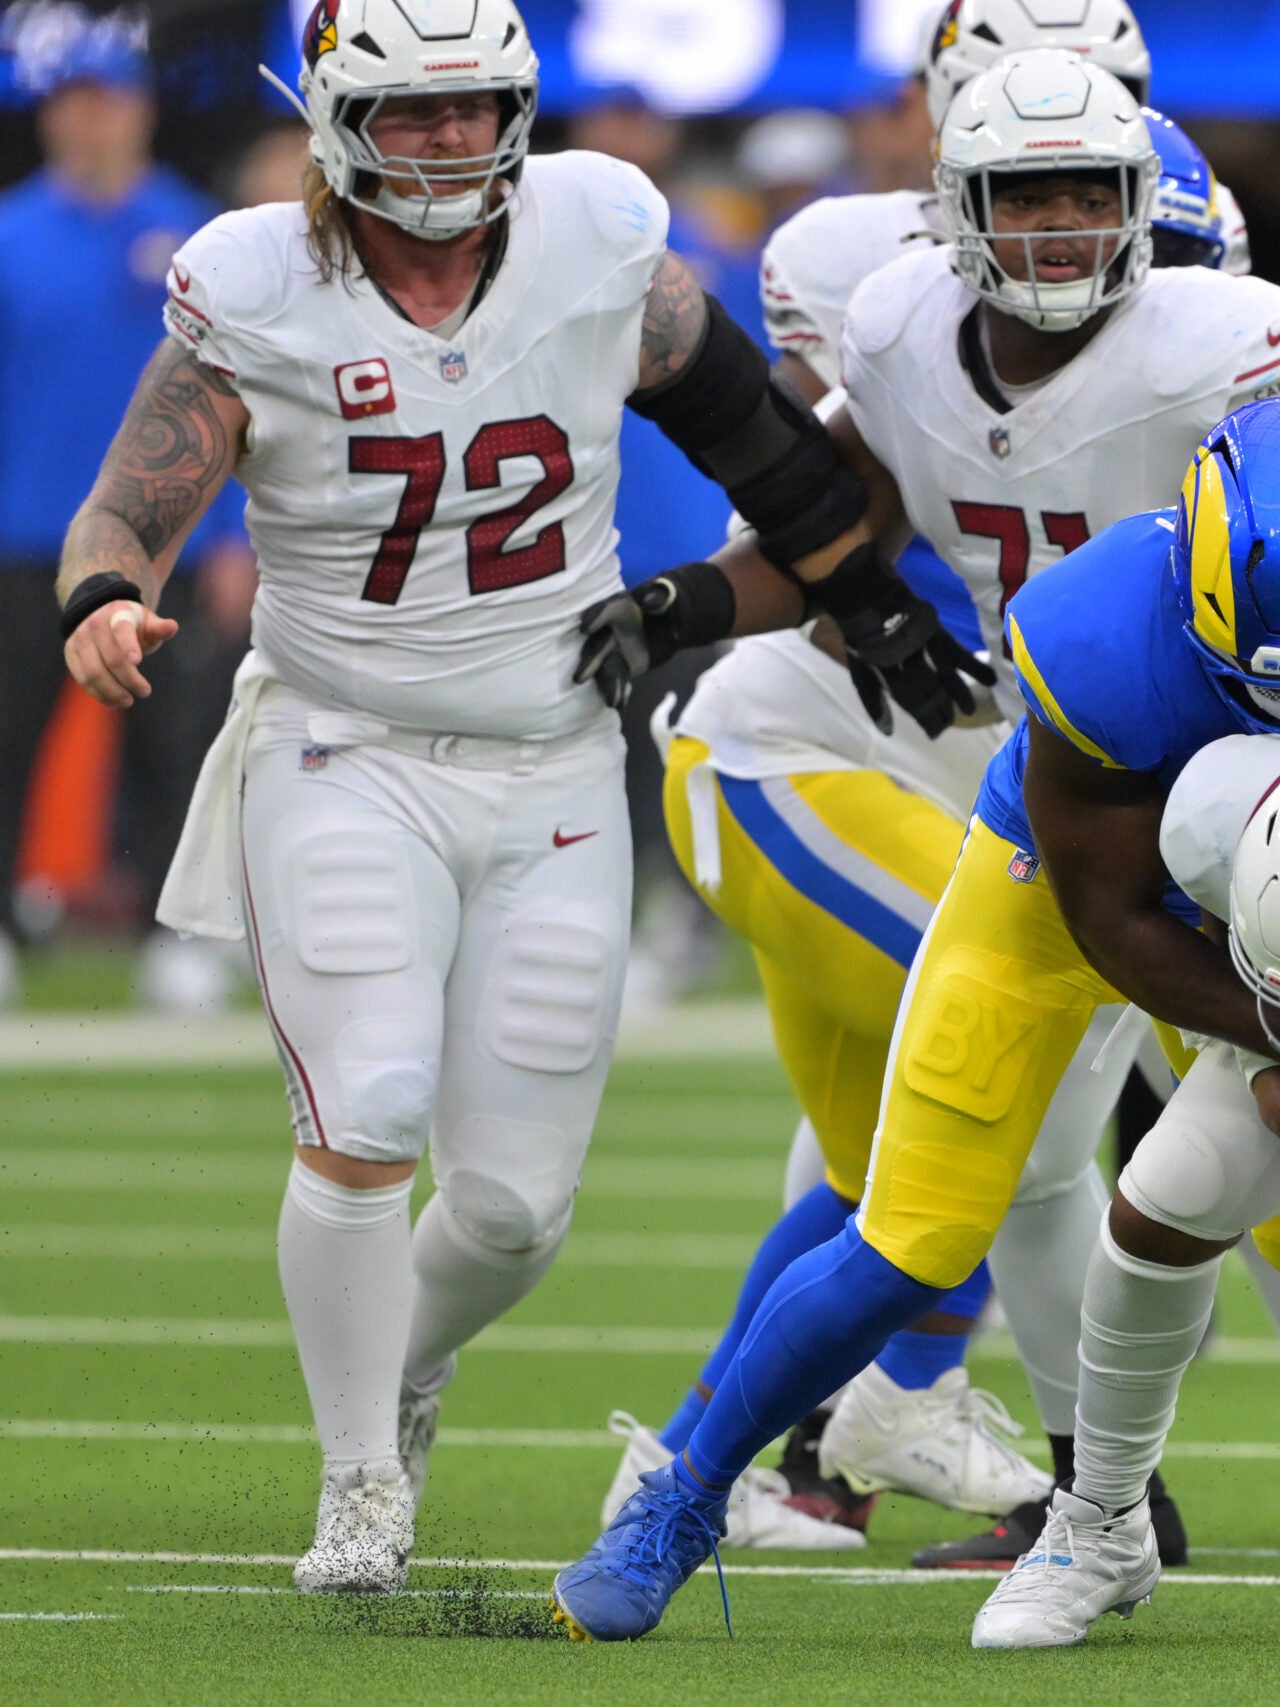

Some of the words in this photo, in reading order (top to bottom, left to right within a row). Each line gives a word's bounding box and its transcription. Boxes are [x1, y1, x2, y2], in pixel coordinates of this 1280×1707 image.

[423, 61, 479, 71] CARDINALS
[1026, 139, 1082, 149] CARDINALS
[339, 361, 389, 405] C
[348, 413, 574, 606] 72
[913, 986, 1037, 1094] BY
